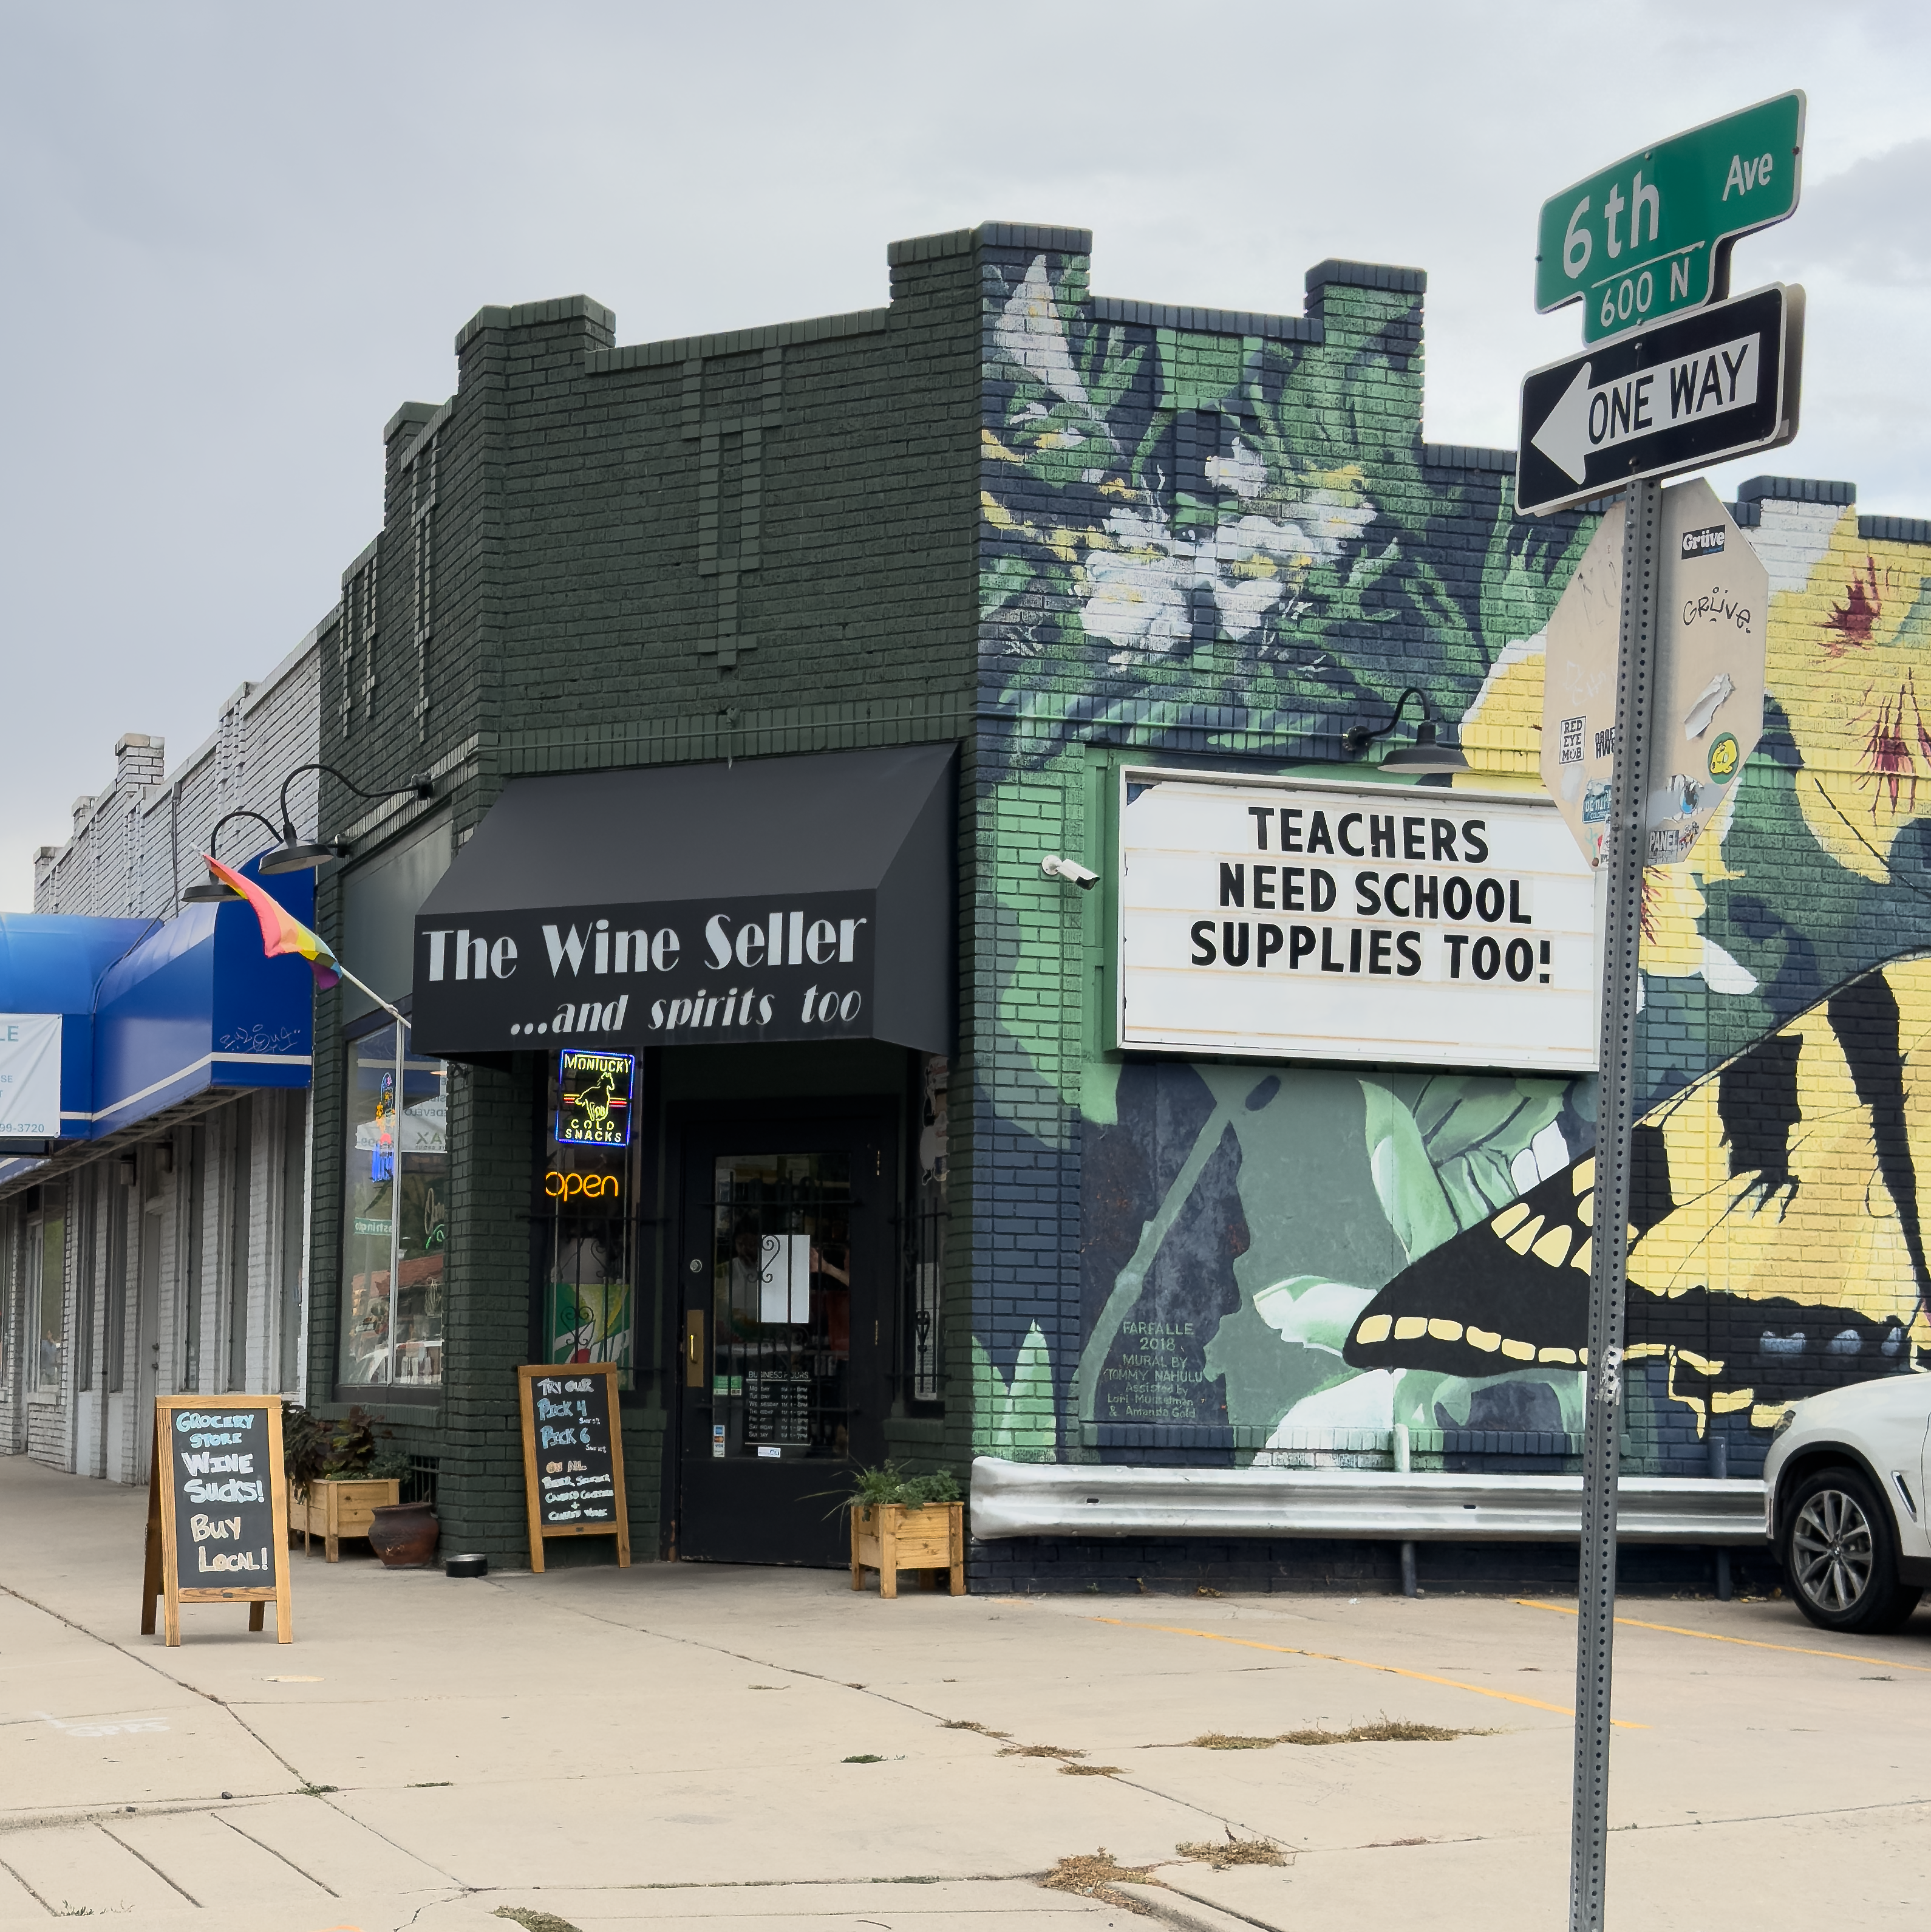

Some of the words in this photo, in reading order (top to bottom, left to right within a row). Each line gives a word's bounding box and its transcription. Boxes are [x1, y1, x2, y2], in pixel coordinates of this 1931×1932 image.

[1563, 171, 1660, 278] 6th
[1723, 153, 1773, 201] Ave
[1600, 271, 1652, 327] 600
[1670, 258, 1689, 301] N
[1588, 374, 1653, 445] ONE
[1669, 344, 1749, 420] WAY
[1564, 720, 1582, 734] RED
[1564, 733, 1581, 747] EYE
[1248, 807, 1488, 863] TEACHERS
[1220, 862, 1337, 912] NEED
[1355, 871, 1531, 924] SCHOOL
[422, 930, 518, 981] The
[542, 919, 680, 978] Wine
[705, 911, 867, 970] Seller
[1190, 920, 1422, 976] SUPPLIES
[1443, 934, 1550, 984] TOO!
[510, 995, 628, 1036] ...and
[648, 988, 775, 1030] spirits
[801, 985, 862, 1024] too
[565, 1128, 622, 1142] SNACKS
[571, 1119, 615, 1131] COLD
[1123, 1322, 1194, 1335] FARFALLE
[1140, 1337, 1176, 1351] 2018
[1123, 1354, 1167, 1368] MURAL
[1172, 1357, 1188, 1370] BY
[1104, 1368, 1149, 1381] TOMMY
[1154, 1370, 1203, 1382] NAHULU
[537, 1378, 562, 1396] TRY
[565, 1378, 594, 1393] OUR
[1125, 1382, 1173, 1393] Assisted
[1176, 1384, 1188, 1396] by
[537, 1398, 574, 1421] PICK
[576, 1400, 587, 1416] 4
[1109, 1405, 1117, 1416] &
[1126, 1405, 1169, 1416] Amanda
[1171, 1407, 1196, 1418] Gold
[176, 1411, 254, 1432] GROCERY
[189, 1432, 242, 1449] STORE
[540, 1425, 577, 1449] PICK
[580, 1427, 590, 1444] 6
[181, 1452, 254, 1476] WINE
[199, 1546, 268, 1572] LOCAL!
